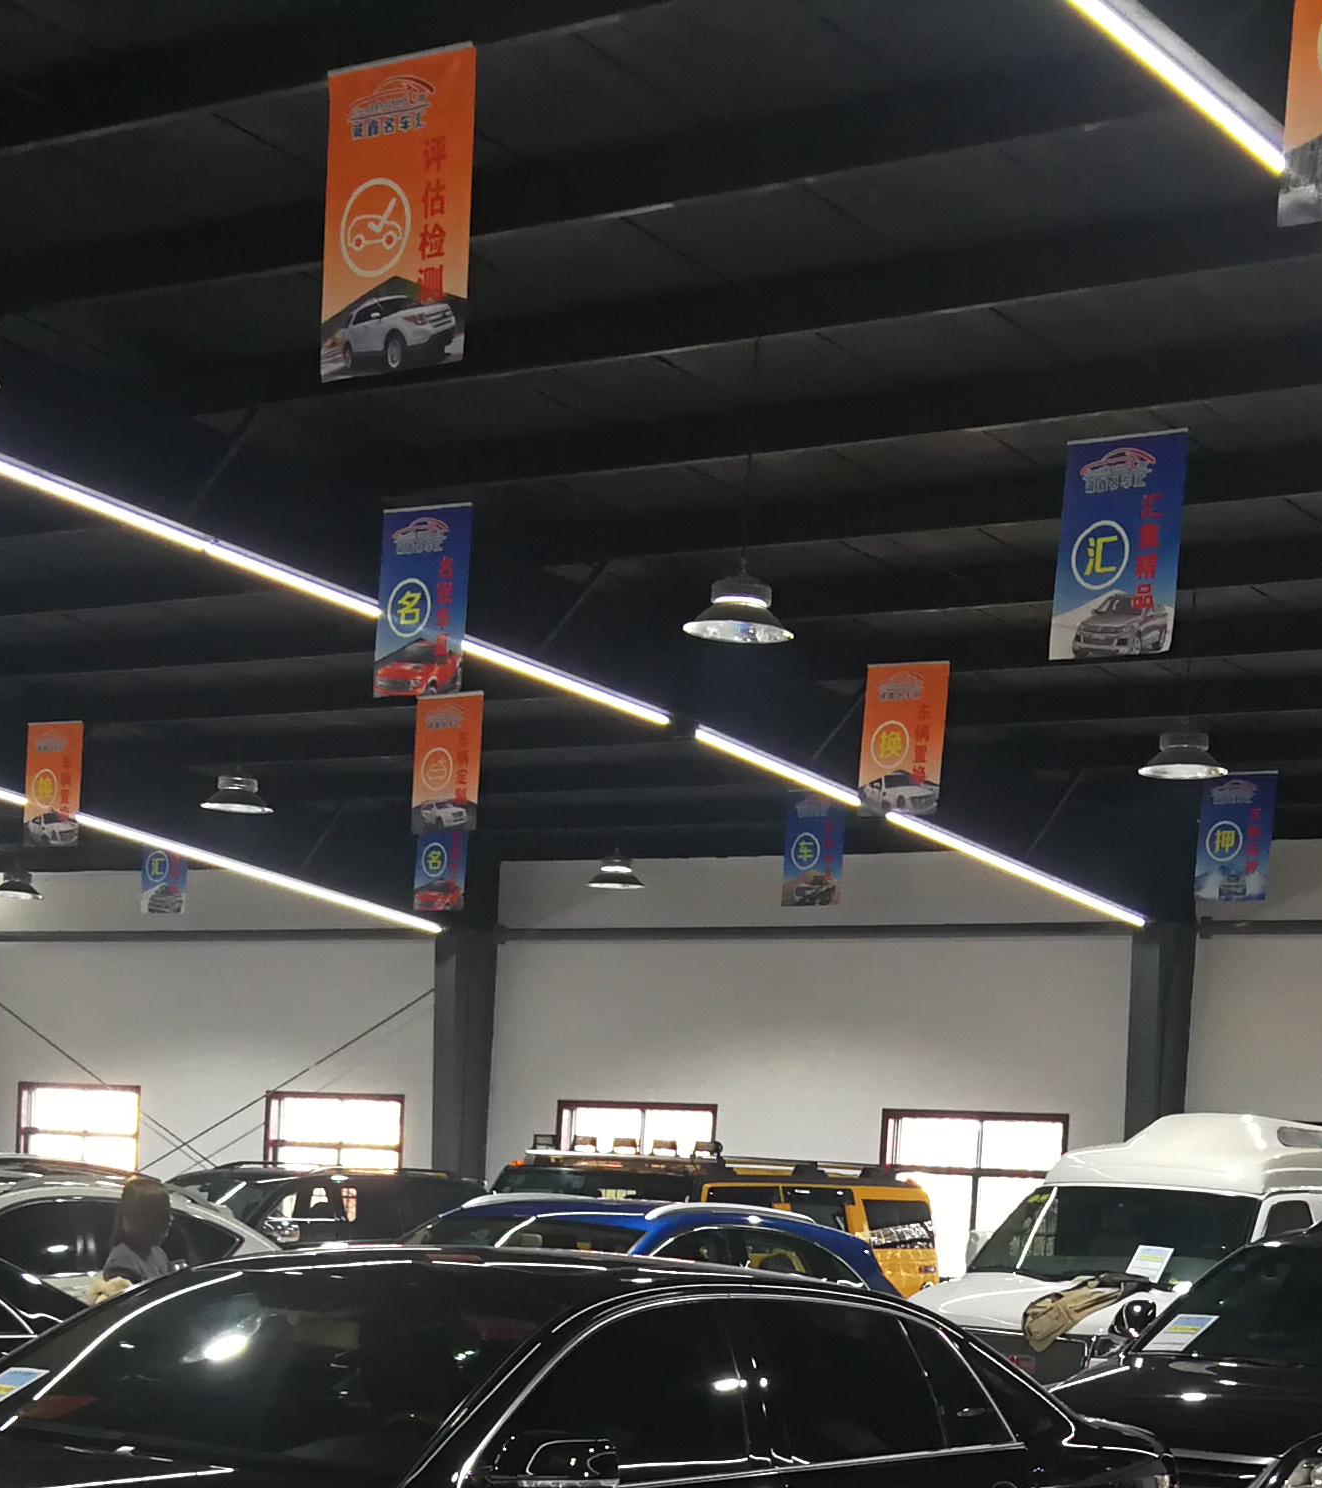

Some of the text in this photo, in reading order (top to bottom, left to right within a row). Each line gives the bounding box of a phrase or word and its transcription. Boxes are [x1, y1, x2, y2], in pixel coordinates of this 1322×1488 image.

[417, 136, 447, 304] 评估检测
[1084, 535, 1119, 577] 汇
[1133, 493, 1165, 609] 汇集精品
[397, 590, 422, 625] 名
[878, 730, 902, 760] 换
[1214, 829, 1236, 854] 押
[427, 850, 442, 871] 名
